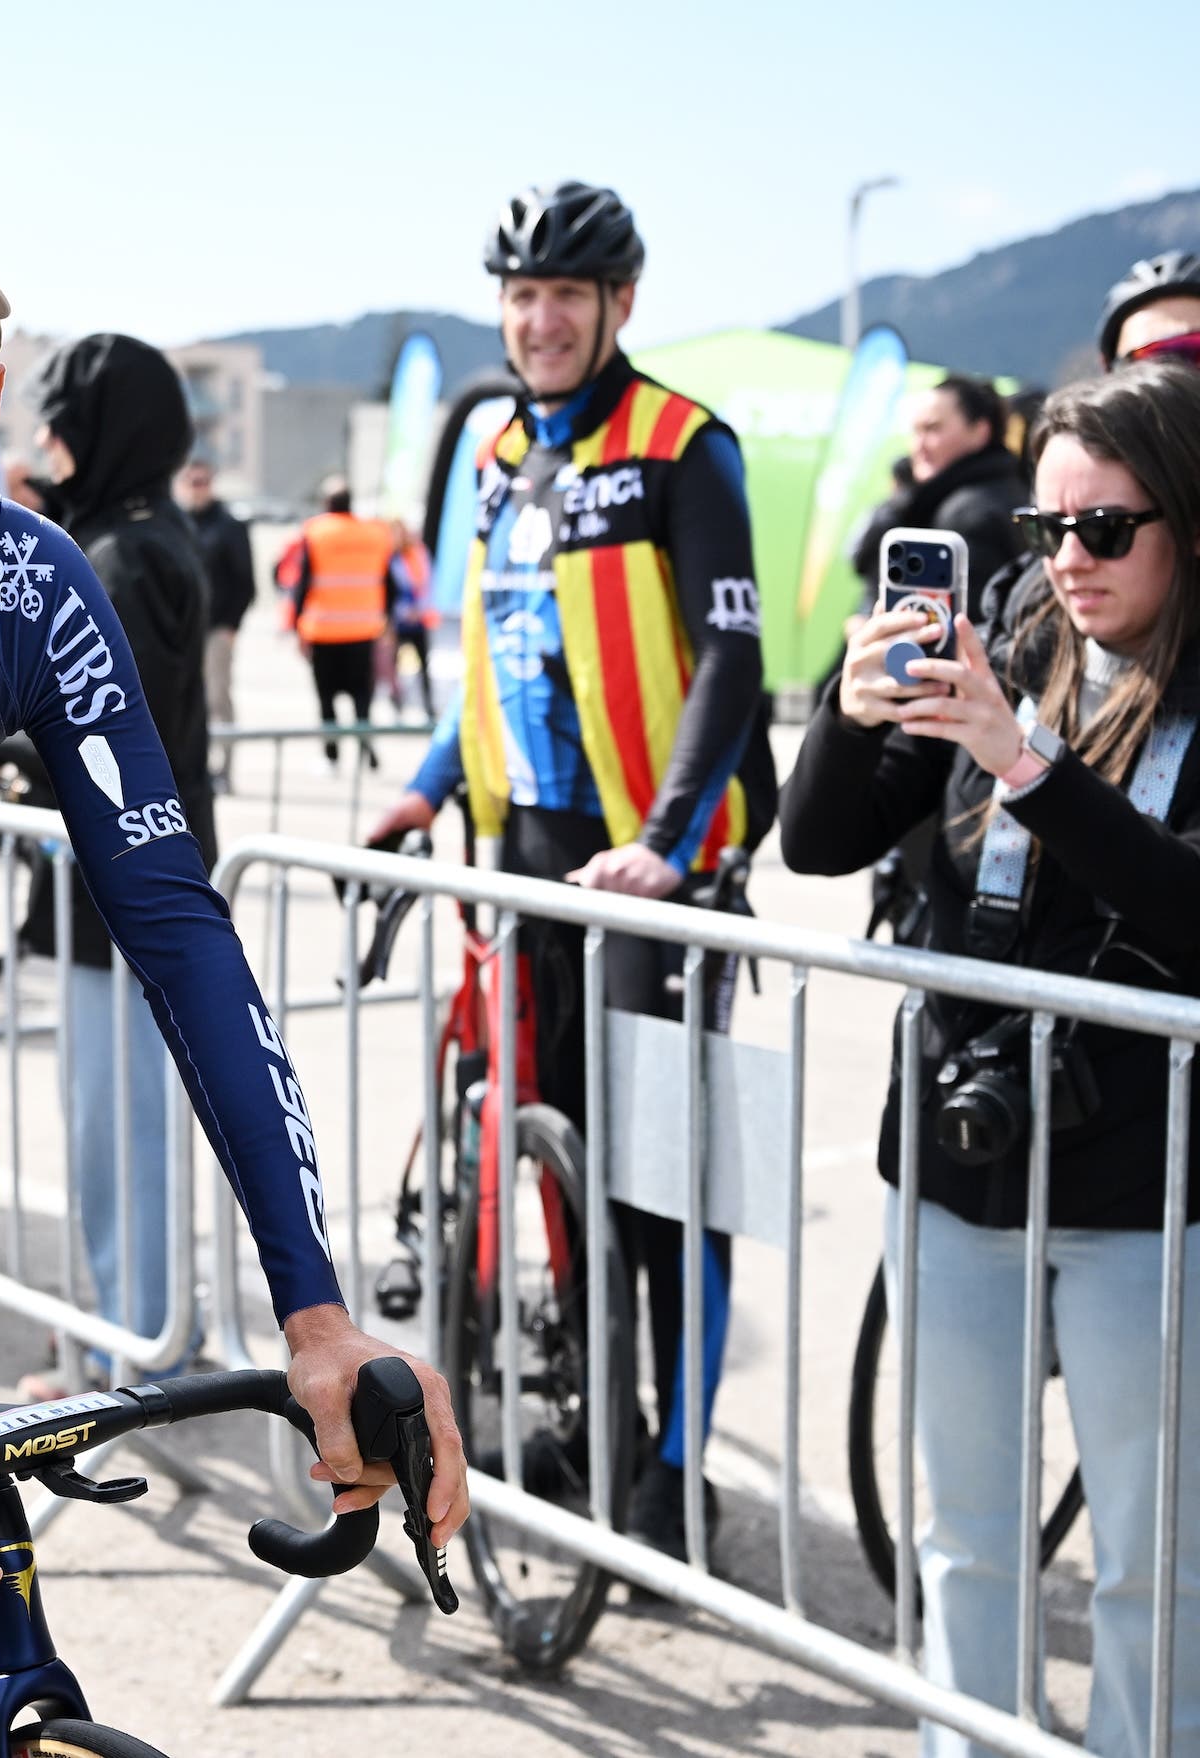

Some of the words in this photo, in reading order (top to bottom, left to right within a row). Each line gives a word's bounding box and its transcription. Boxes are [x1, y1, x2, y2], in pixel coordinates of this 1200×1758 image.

[46, 585, 127, 726] UBS
[117, 798, 188, 847] SGS
[4, 1420, 97, 1462] MOST
